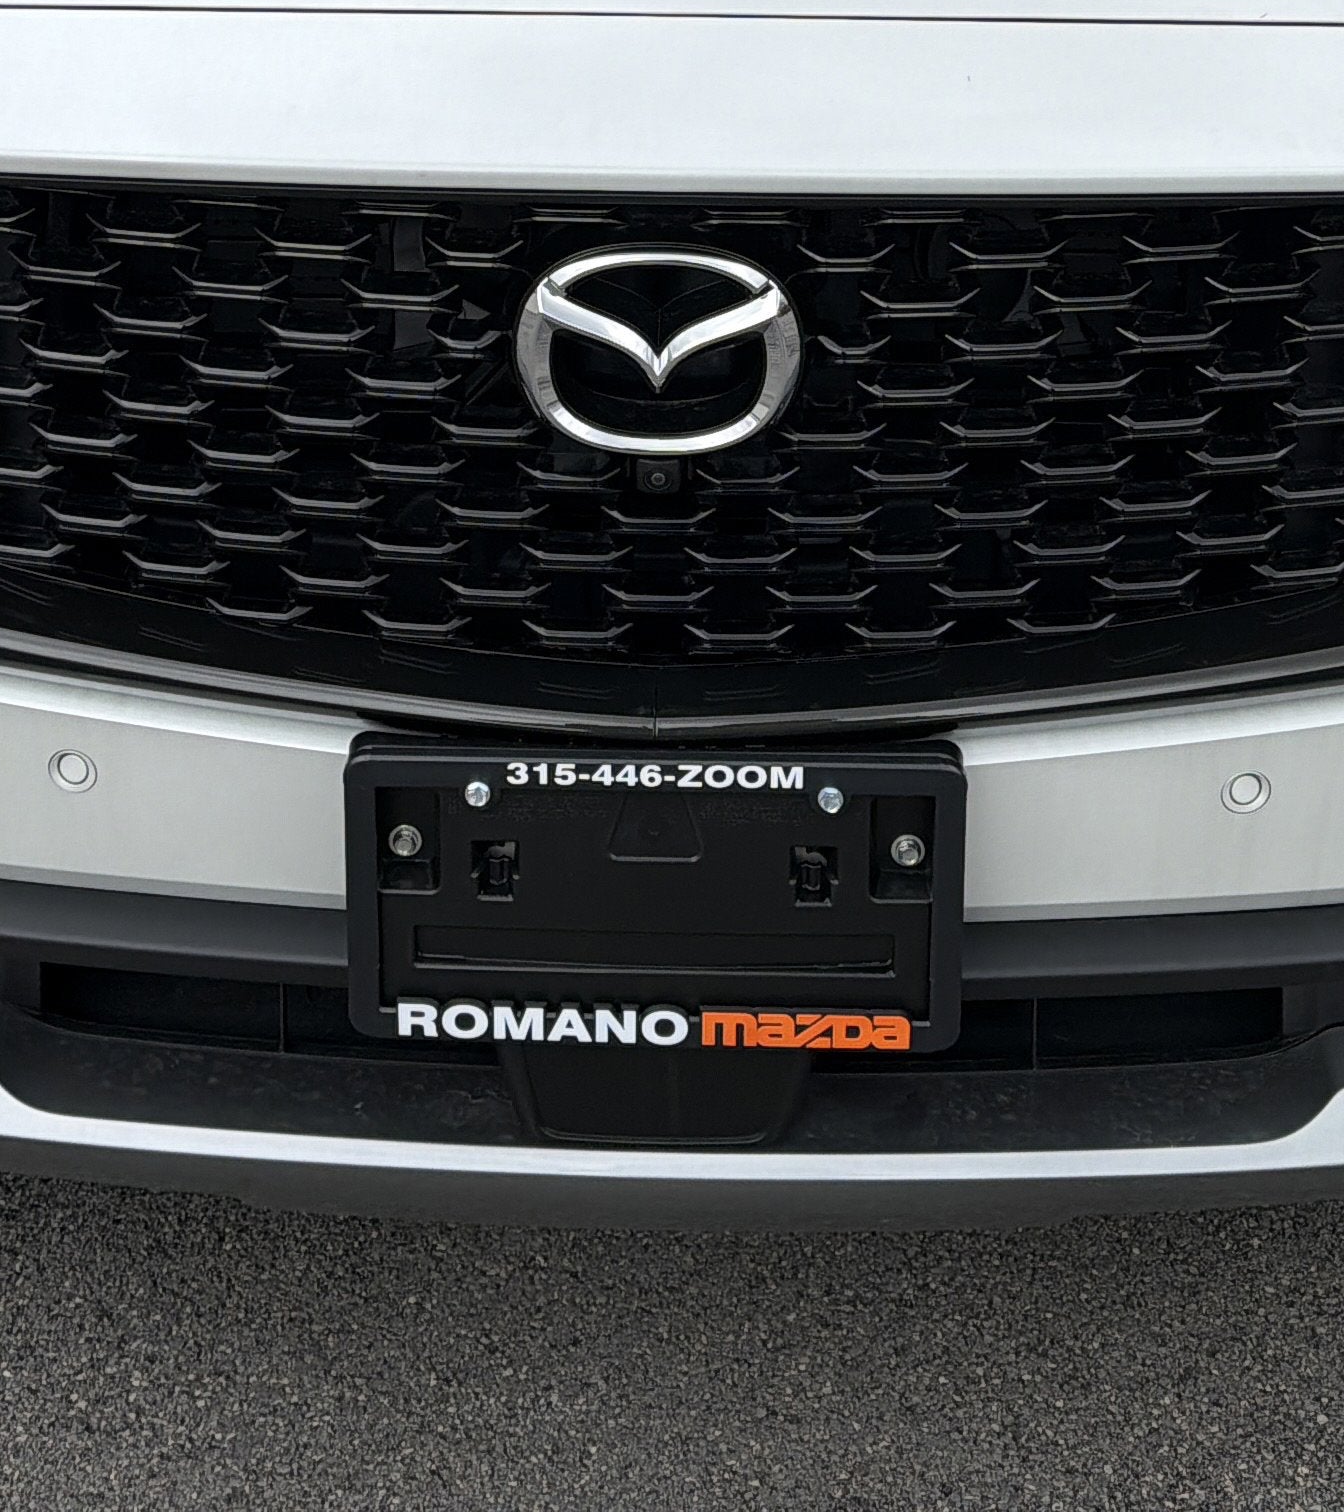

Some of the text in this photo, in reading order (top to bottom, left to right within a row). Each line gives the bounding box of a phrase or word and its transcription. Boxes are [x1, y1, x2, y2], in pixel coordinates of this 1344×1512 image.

[506, 760, 805, 790] 315-446-ZOOM
[396, 1003, 912, 1051] ROMANO mazda
